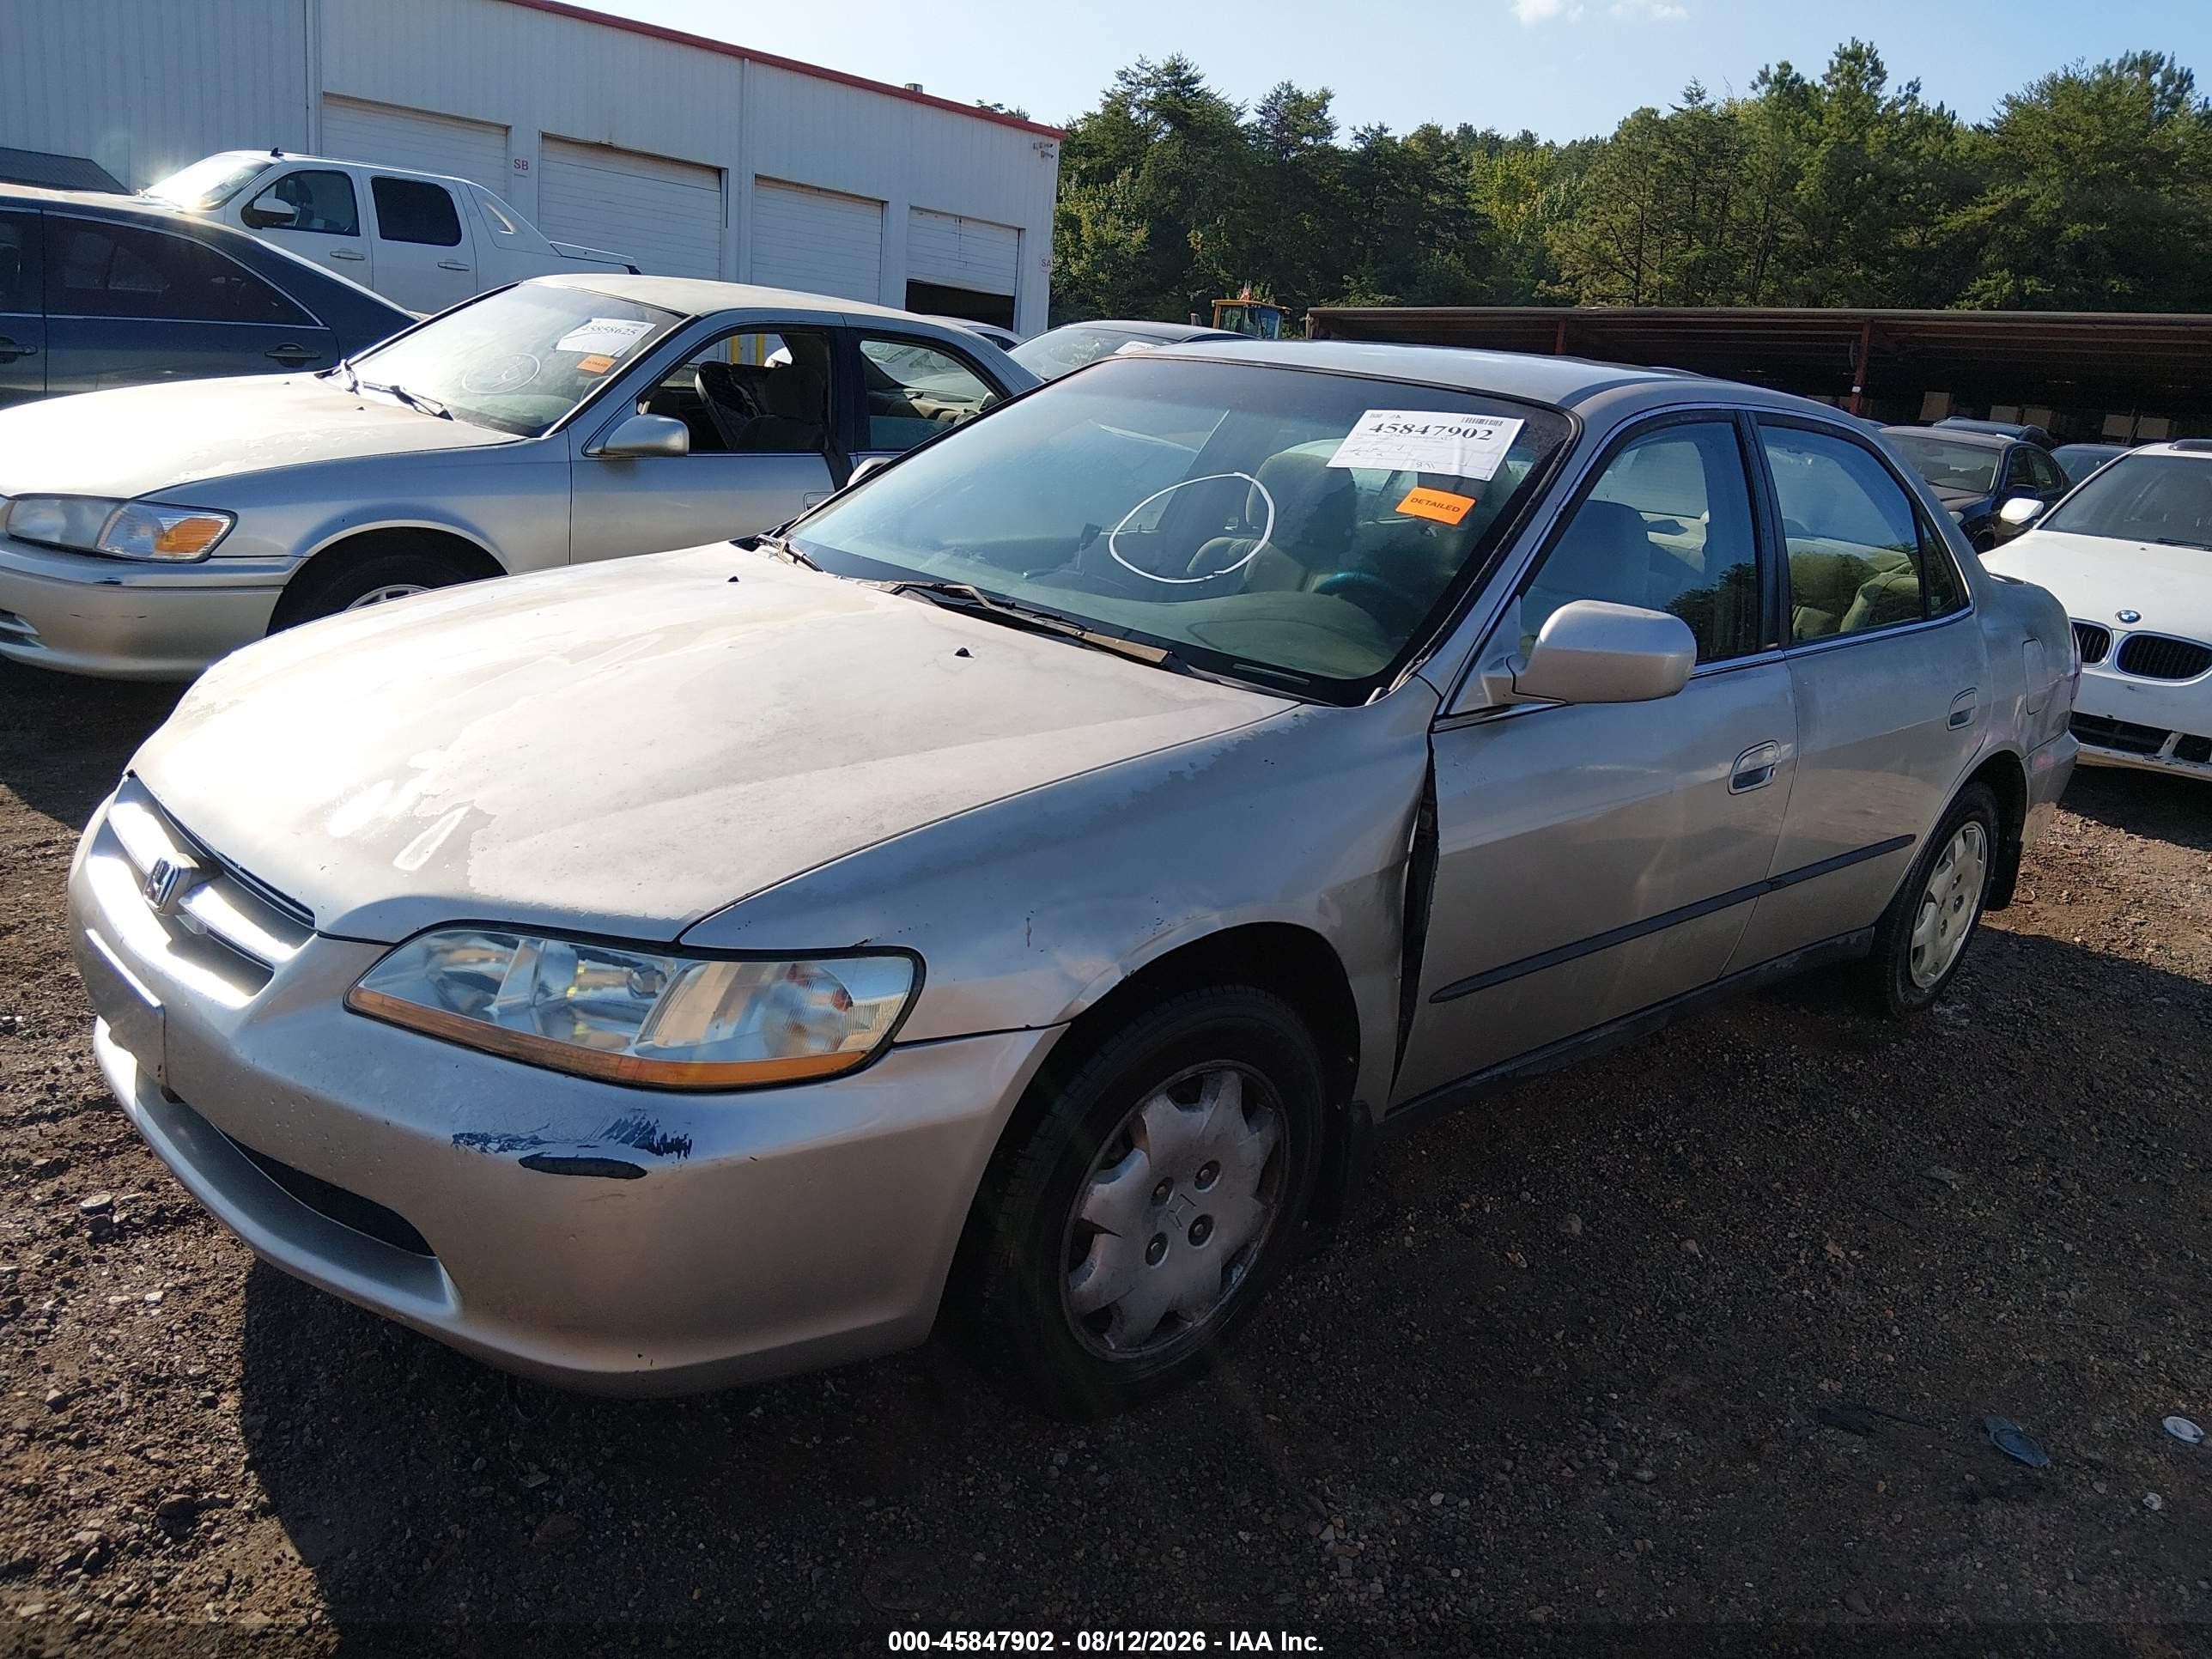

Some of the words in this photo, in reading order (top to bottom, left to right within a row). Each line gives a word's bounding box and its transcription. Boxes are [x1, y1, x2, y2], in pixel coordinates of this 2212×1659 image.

[514, 158, 529, 171] SB
[1368, 422, 1493, 441] 45847902
[1410, 497, 1461, 513] DETAILED
